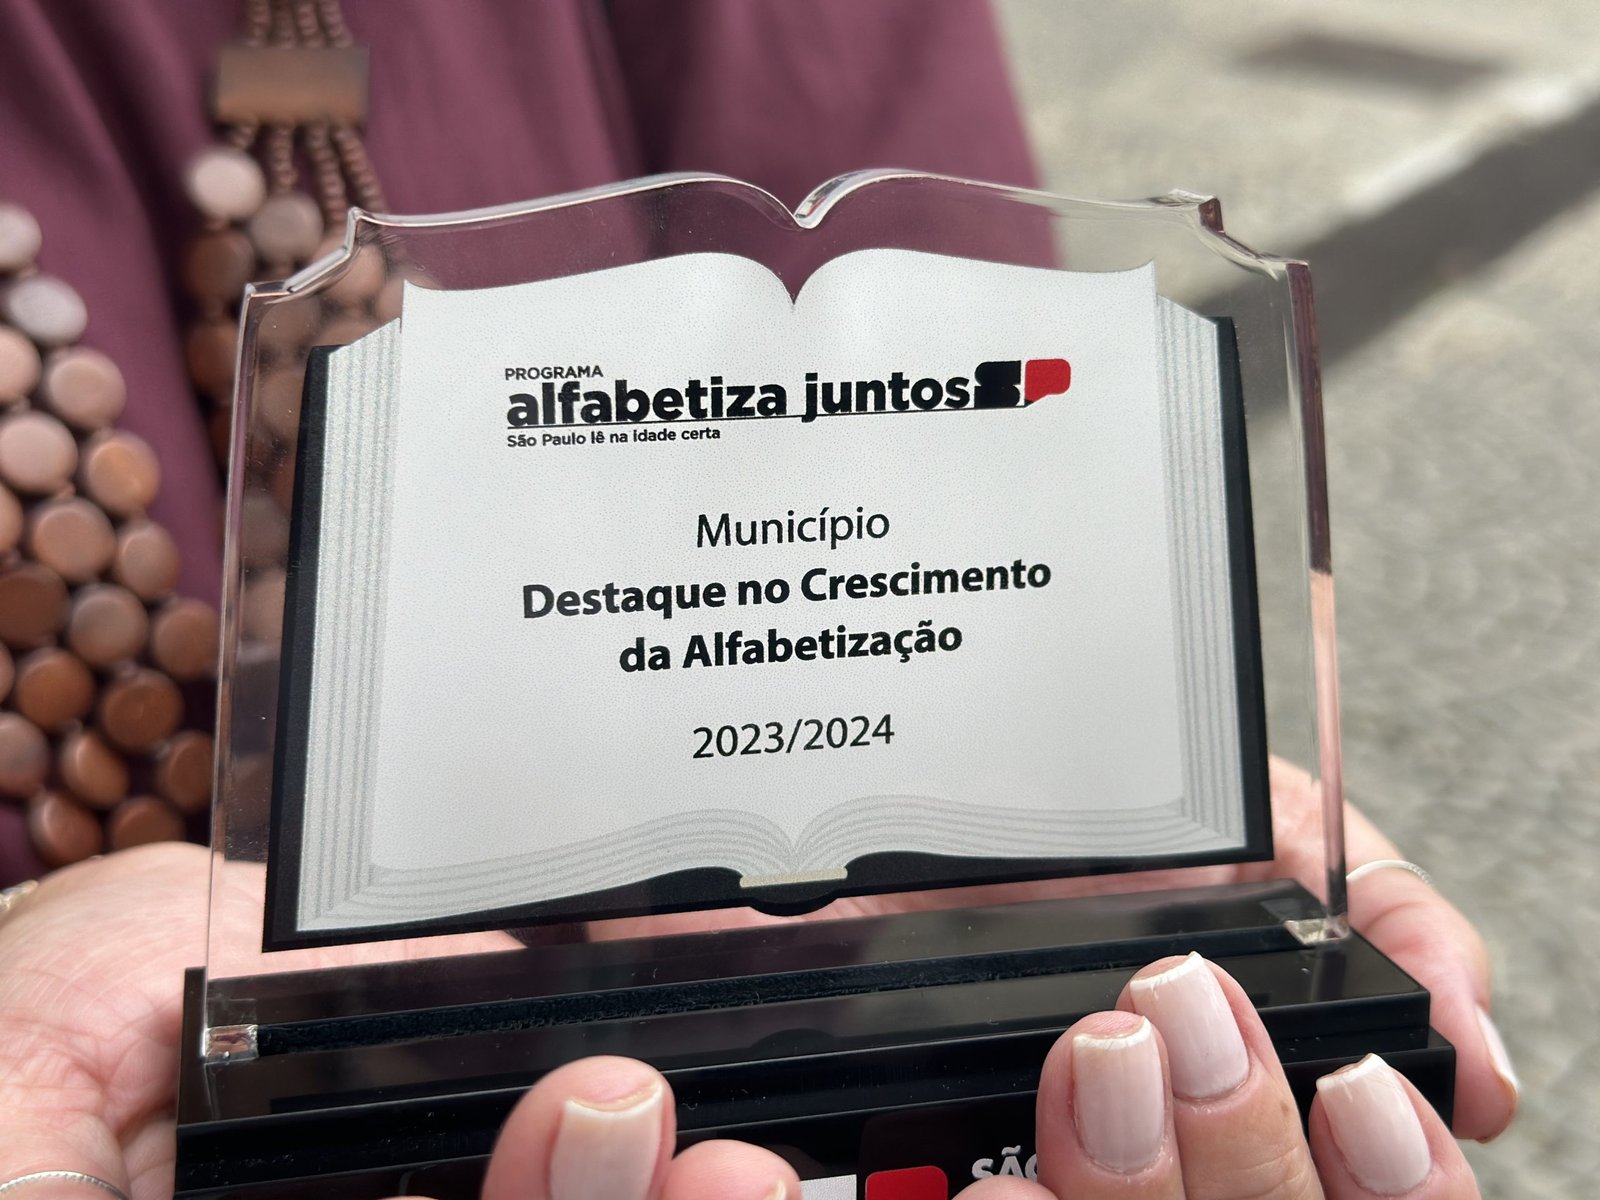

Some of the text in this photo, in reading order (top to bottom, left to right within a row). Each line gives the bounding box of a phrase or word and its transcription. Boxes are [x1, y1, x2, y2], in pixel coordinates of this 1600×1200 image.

[505, 365, 604, 381] PROGRAMA
[506, 374, 789, 424] alfabetiza
[801, 371, 970, 423] juntos
[507, 433, 537, 448] São
[542, 431, 587, 446] Paulo
[609, 432, 628, 444] na
[681, 427, 721, 442] certa
[696, 506, 890, 550] Município
[522, 558, 1052, 620] Destaque no Crescimento
[619, 619, 963, 673] da Alfabetização
[692, 713, 895, 759] 2023/2024
